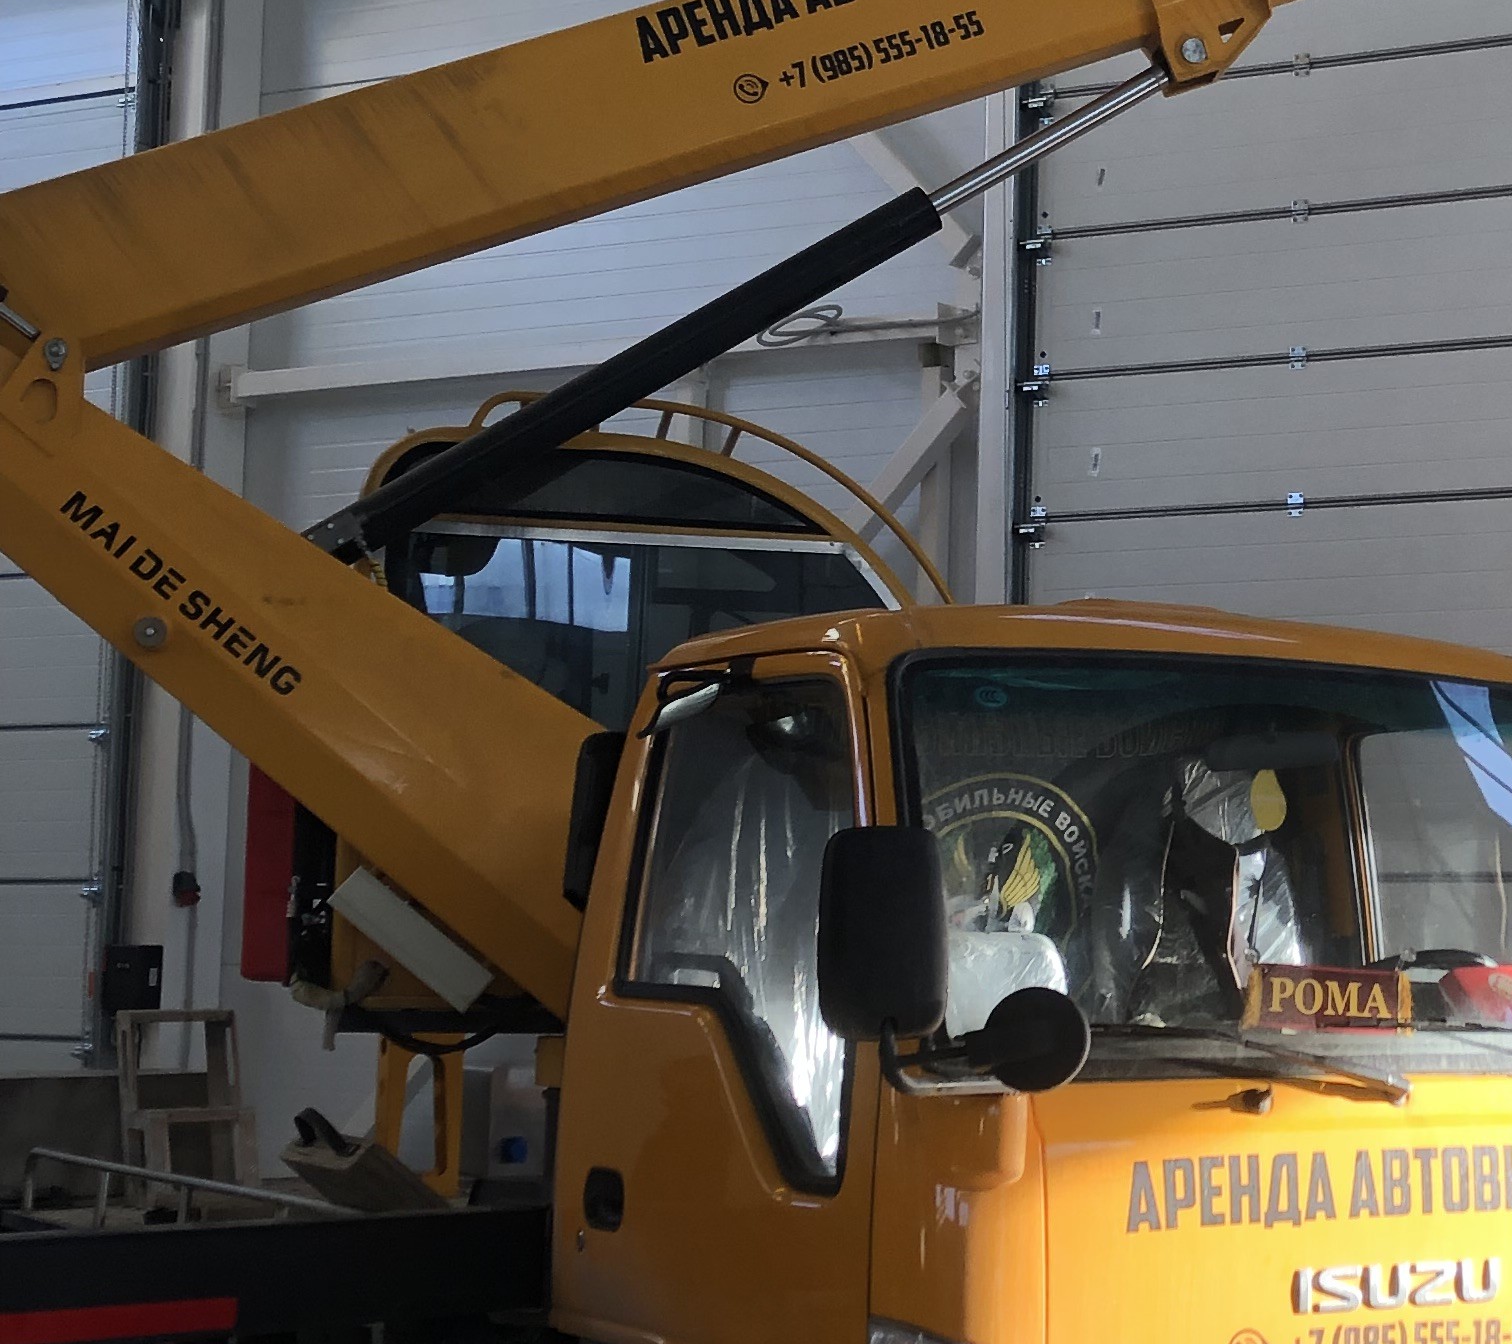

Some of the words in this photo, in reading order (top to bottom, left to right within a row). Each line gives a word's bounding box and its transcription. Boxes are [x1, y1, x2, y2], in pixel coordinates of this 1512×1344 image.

[779, 61, 806, 90] +7
[812, 43, 873, 87] (985)
[873, 10, 985, 66] 555-18-55
[59, 490, 137, 559] MAI
[128, 548, 187, 601] DE
[178, 590, 301, 696] SHENG
[1268, 975, 1392, 1019] РОМА
[1125, 1151, 1337, 1235] АРЕНДА
[1289, 1257, 1501, 1316] ISUZU
